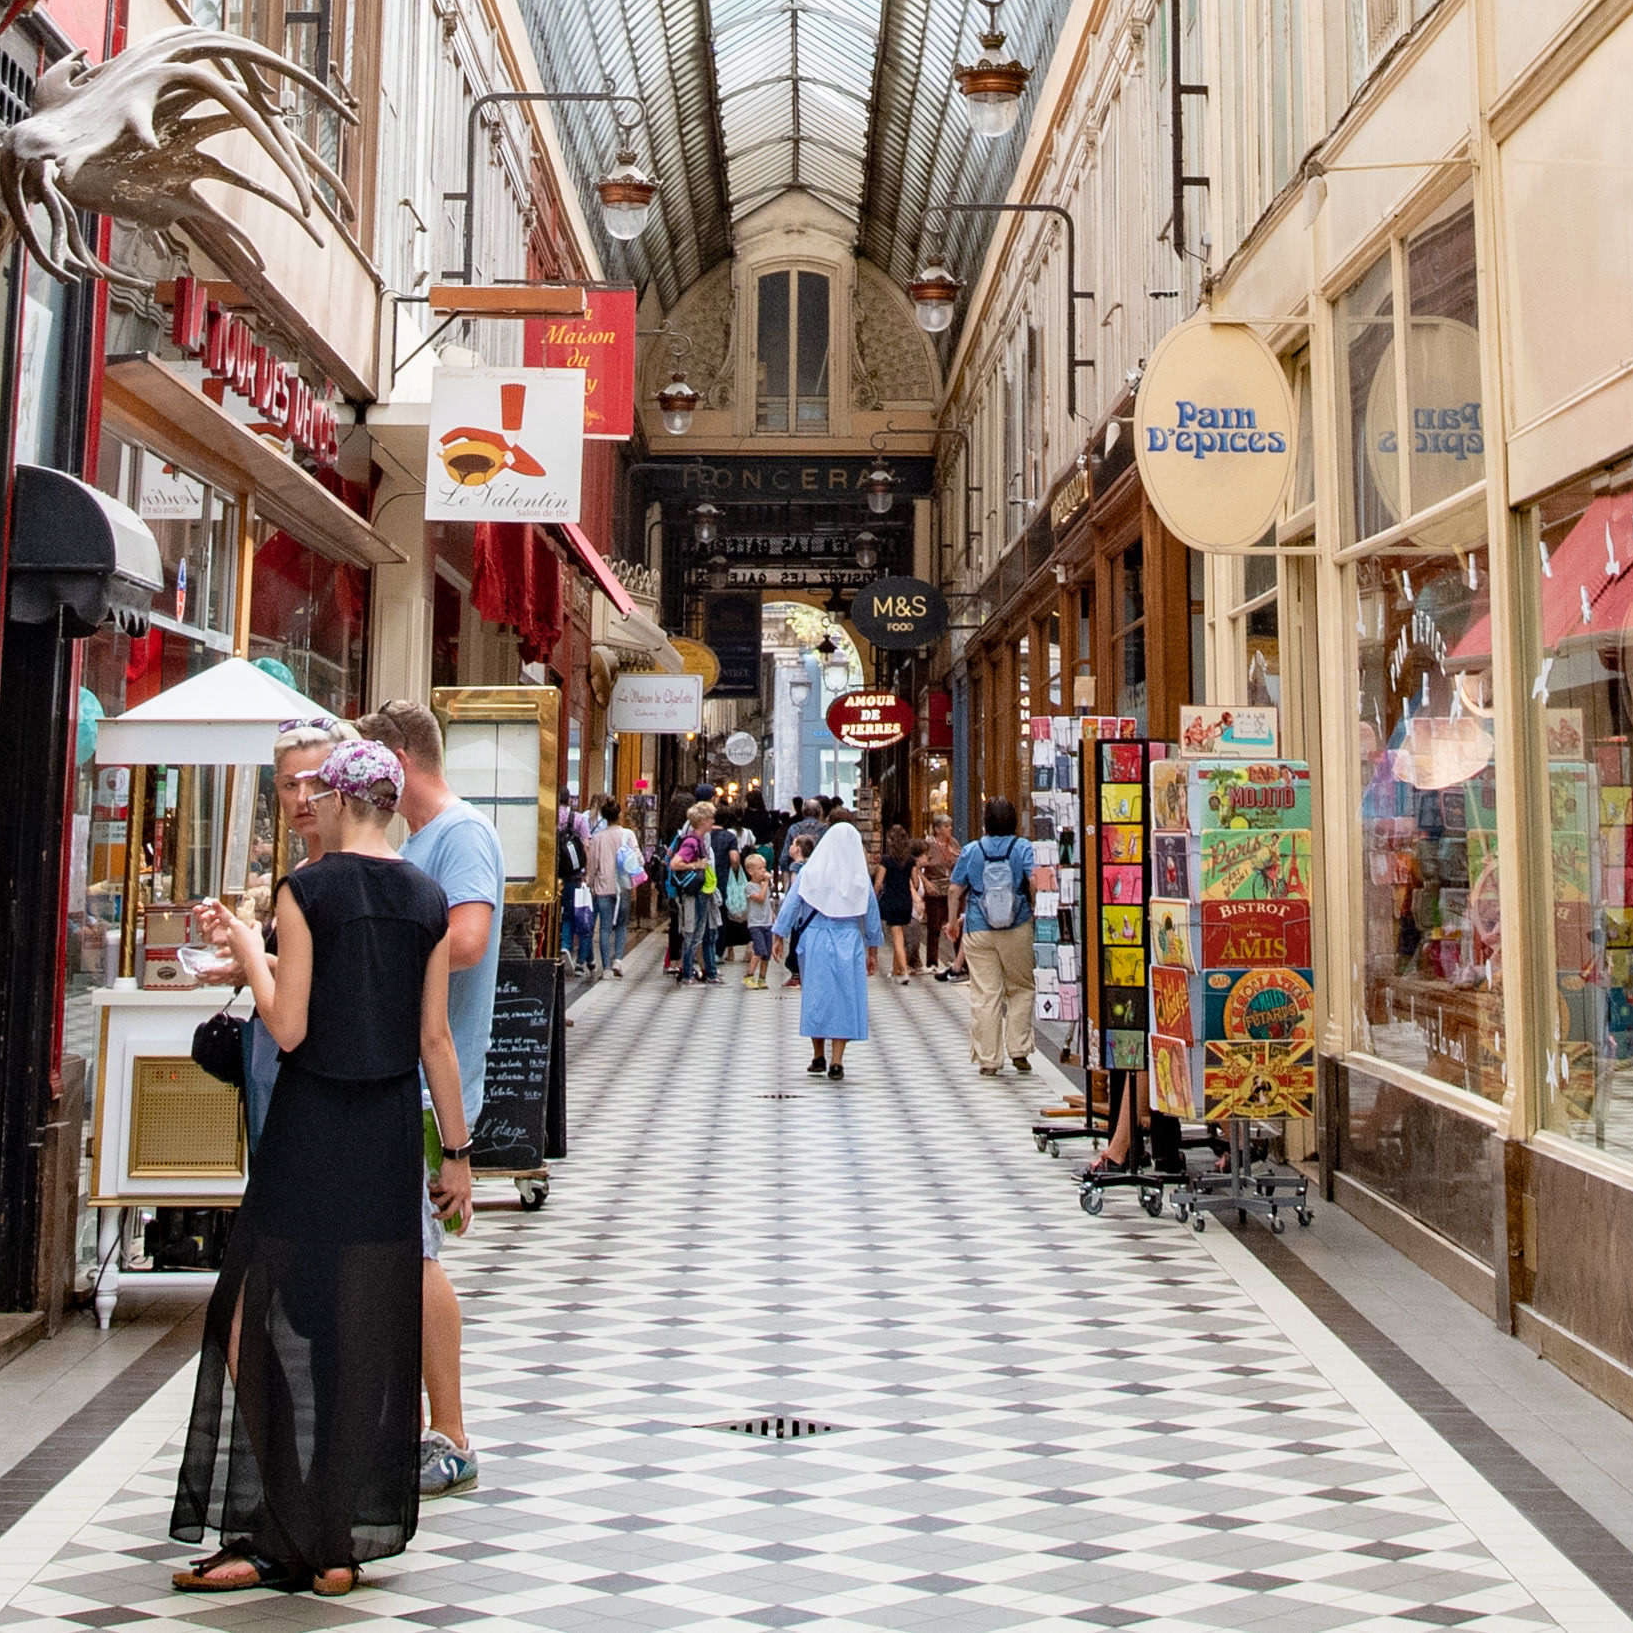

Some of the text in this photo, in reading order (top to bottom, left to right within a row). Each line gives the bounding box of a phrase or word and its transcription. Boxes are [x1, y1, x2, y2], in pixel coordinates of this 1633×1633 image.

[541, 324, 616, 344] Maison
[566, 347, 591, 368] du
[1176, 400, 1256, 430] Pain
[437, 480, 569, 509] Le Valentin
[873, 596, 927, 618] M&S
[887, 622, 914, 632] FOOD
[844, 695, 896, 708] AMOUR
[860, 709, 881, 721] DE
[840, 723, 902, 736] PIERRES
[1229, 785, 1296, 808] MOJITO
[1209, 834, 1263, 880] Paris
[1219, 902, 1291, 918] BISTROT
[1220, 937, 1288, 960] AMIS
